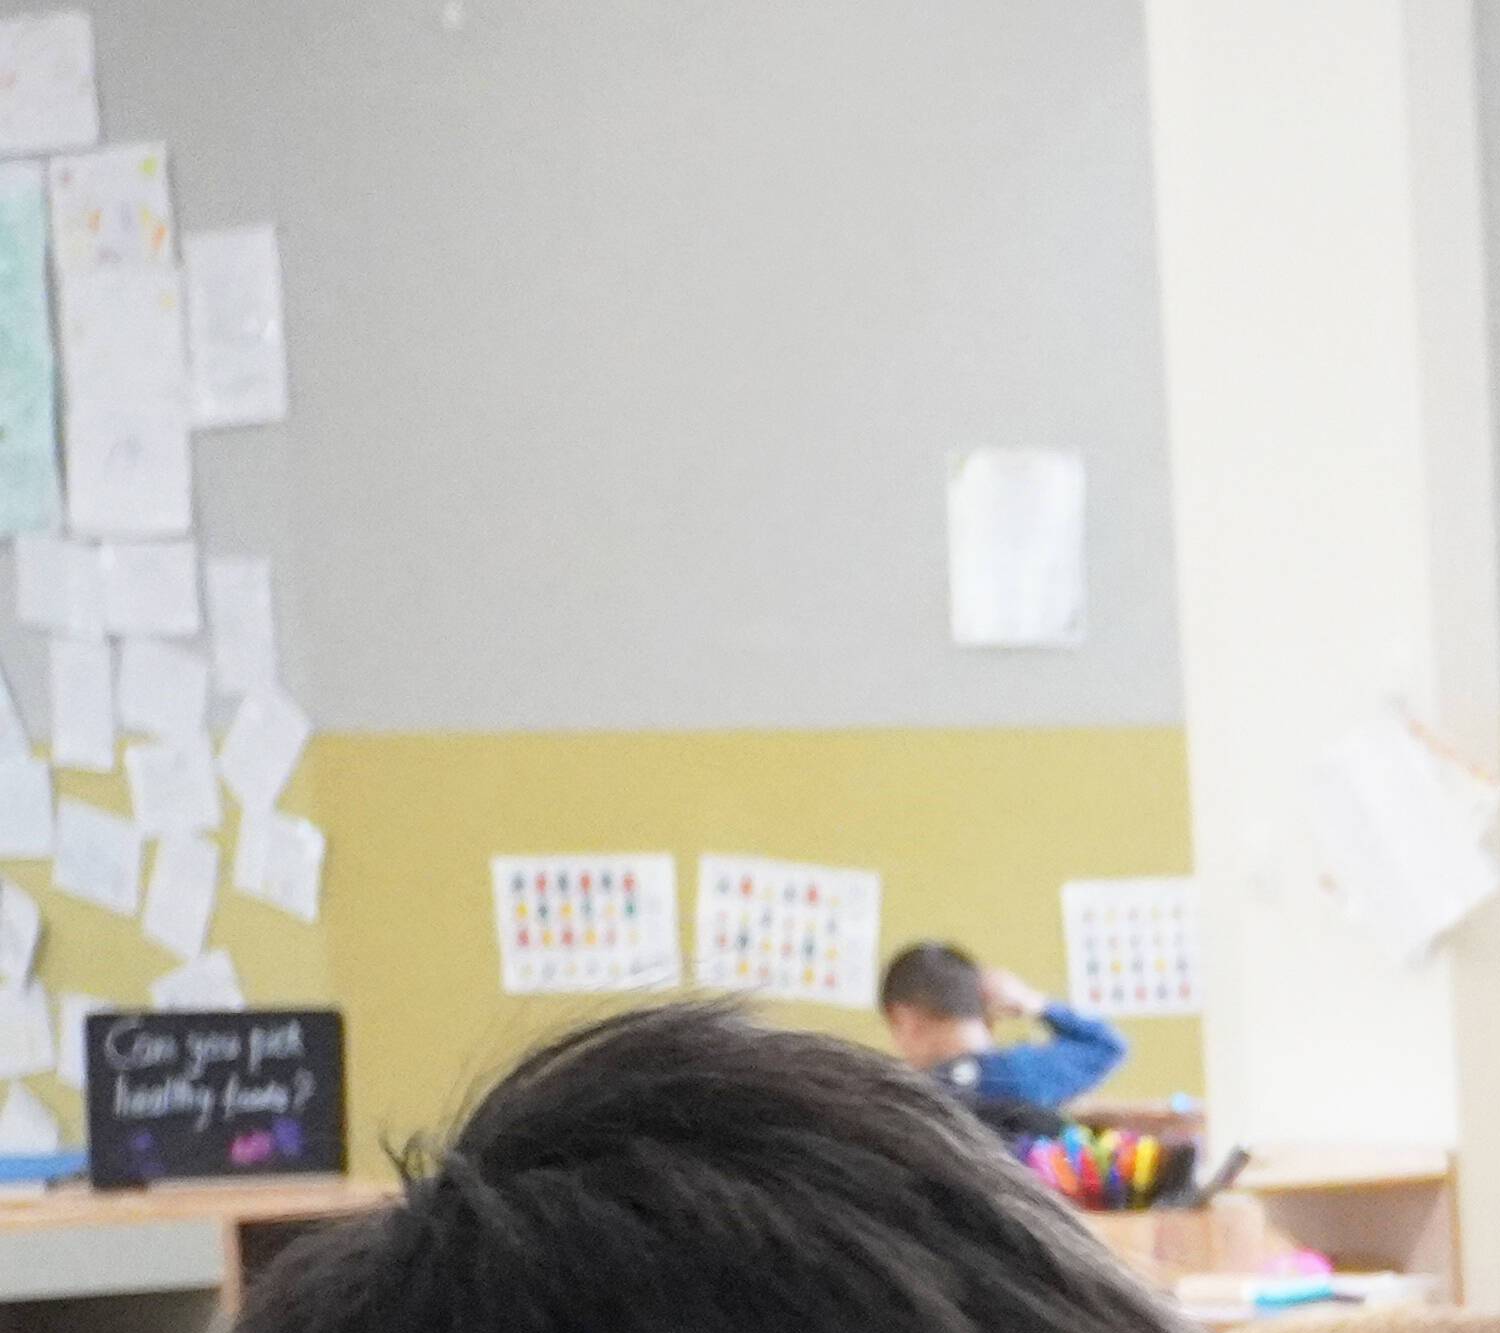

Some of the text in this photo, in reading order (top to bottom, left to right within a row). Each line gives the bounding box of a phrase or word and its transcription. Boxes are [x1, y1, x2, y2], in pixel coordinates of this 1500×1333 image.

[104, 1014, 177, 1071] Can
[186, 1030, 240, 1080] you
[114, 1072, 214, 1132] healthy
